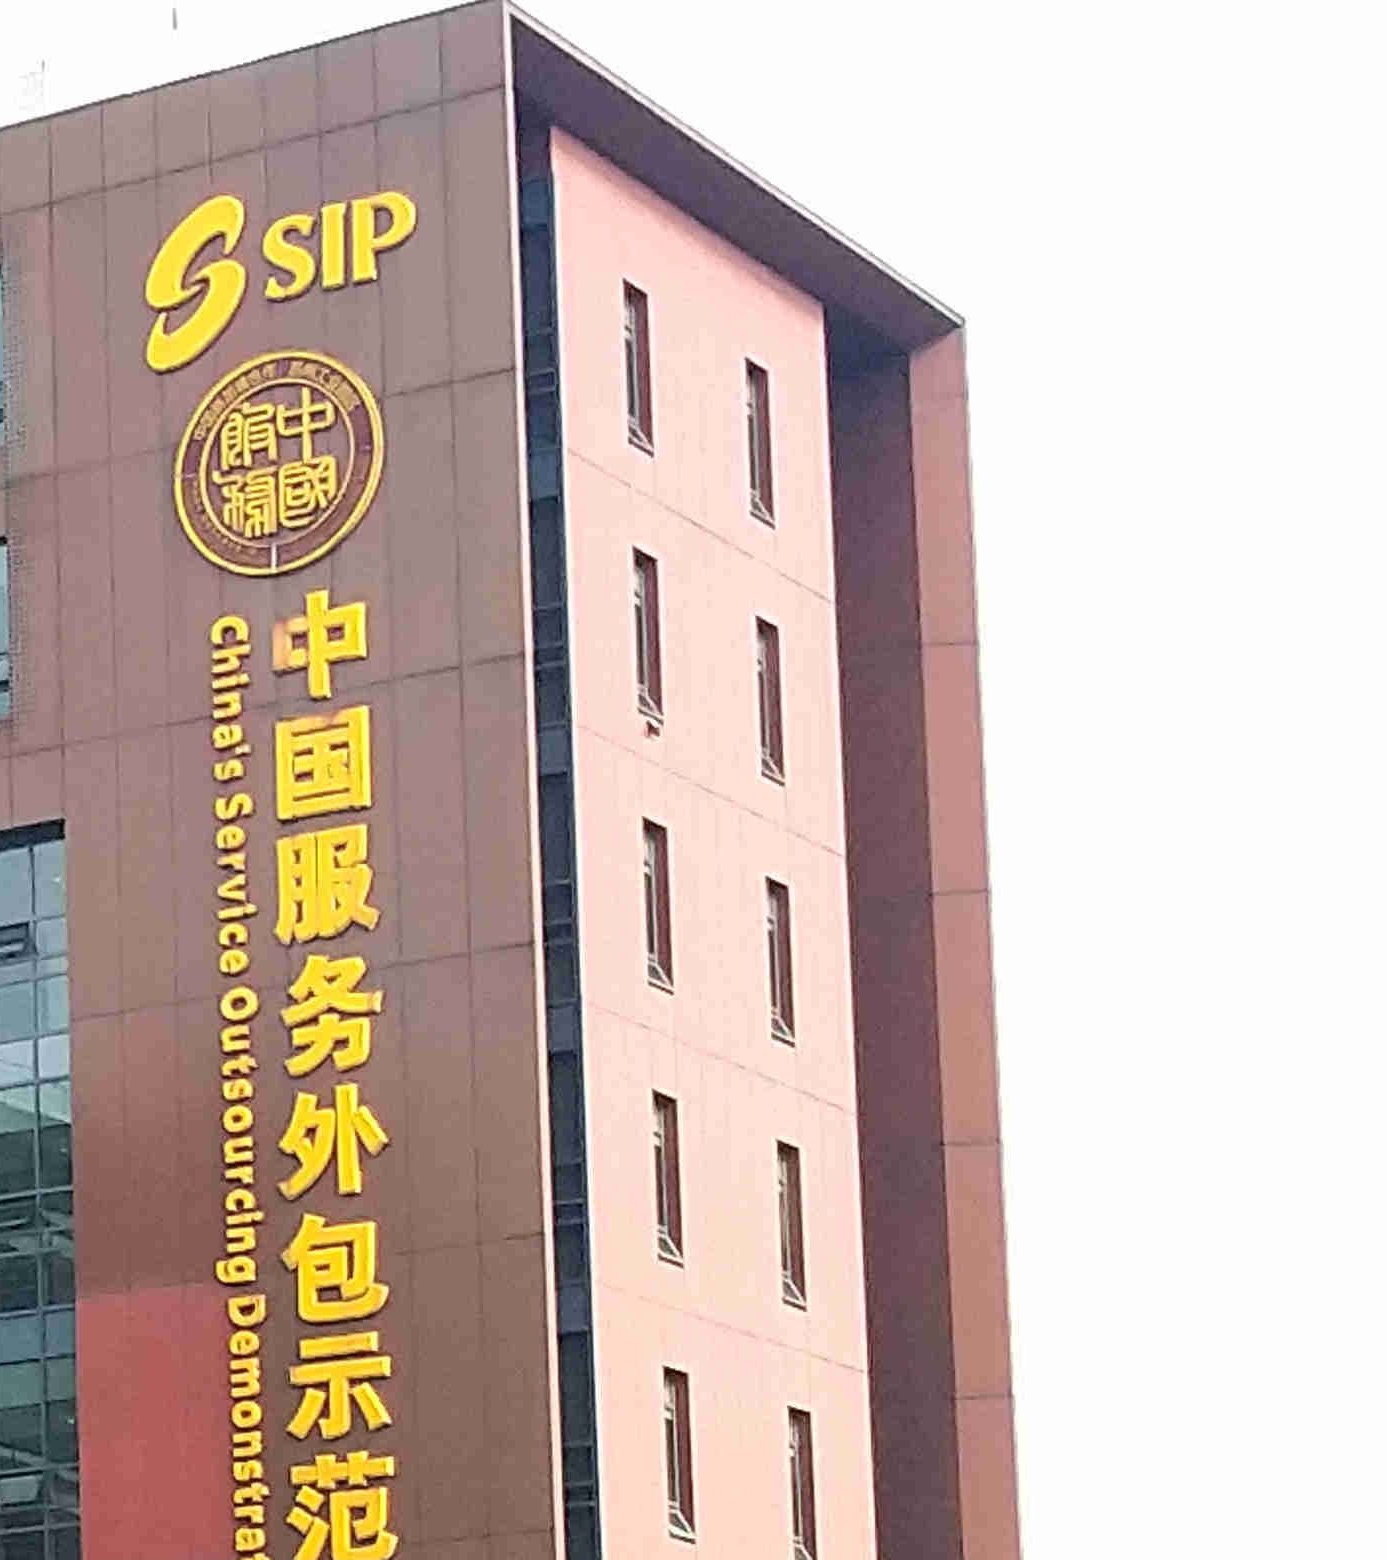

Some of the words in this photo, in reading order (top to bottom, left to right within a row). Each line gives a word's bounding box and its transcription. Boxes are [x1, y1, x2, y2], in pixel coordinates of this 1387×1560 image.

[261, 190, 417, 301] SIP
[208, 614, 251, 782] China's
[213, 791, 257, 981] Service
[215, 983, 269, 1286] Outsourcing
